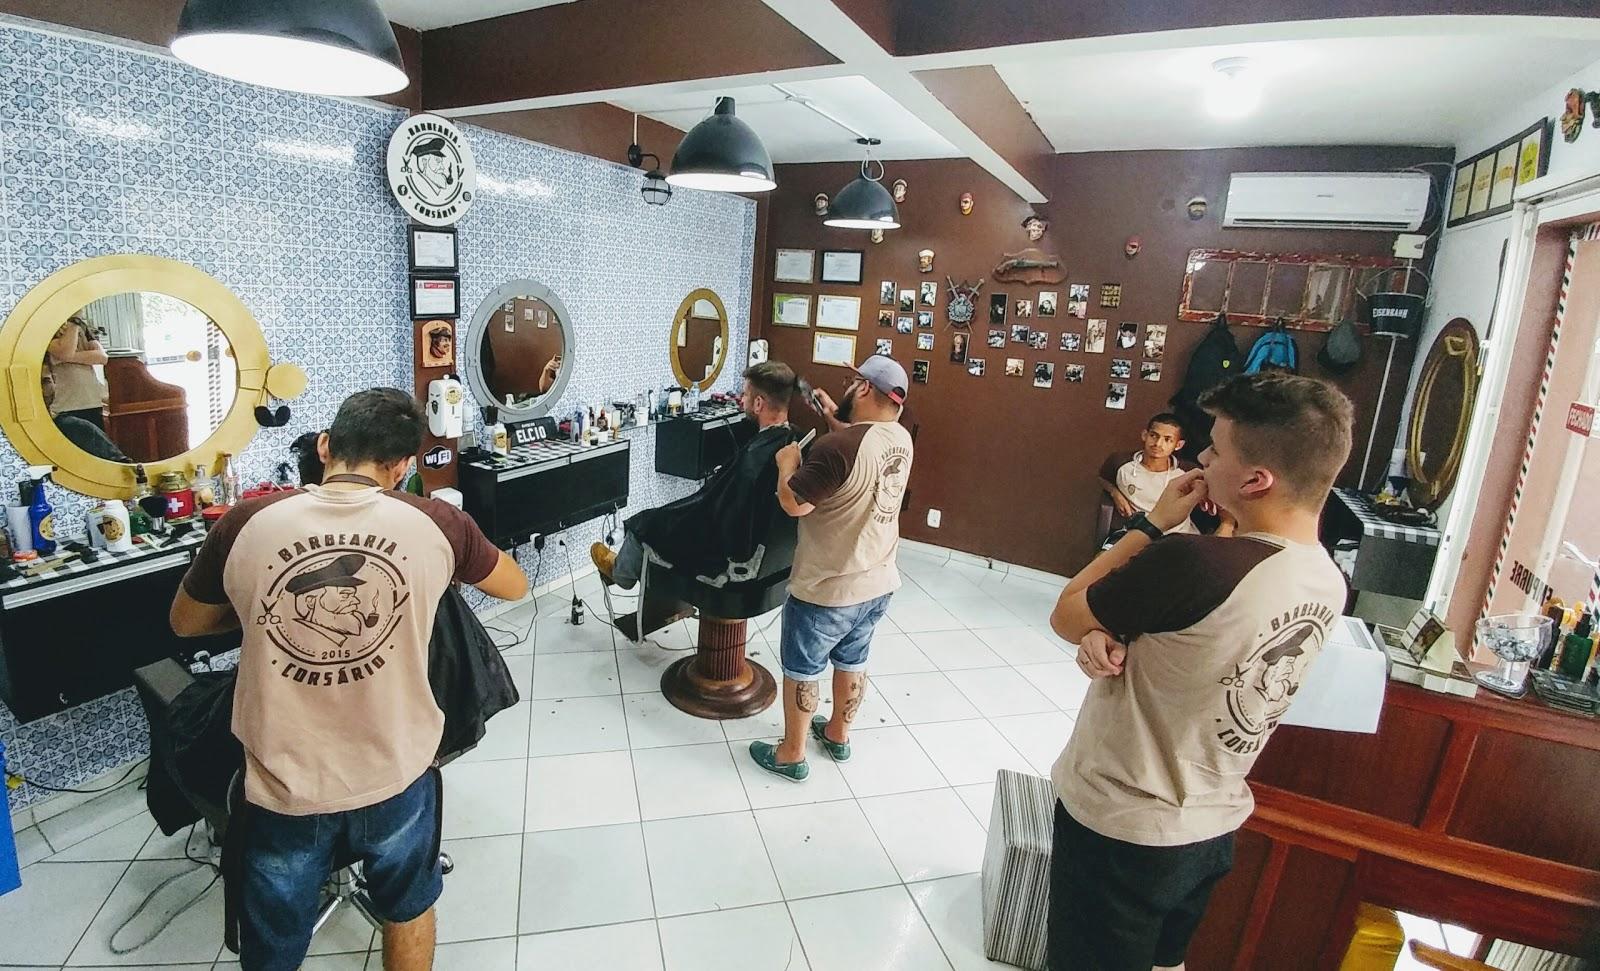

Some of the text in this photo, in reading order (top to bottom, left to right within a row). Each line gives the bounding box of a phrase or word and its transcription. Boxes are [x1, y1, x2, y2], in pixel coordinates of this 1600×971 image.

[408, 122, 458, 144] BARBEARIA
[414, 202, 457, 219] CORSÁRIO
[515, 425, 547, 443] ELCIO
[277, 533, 398, 563] BARBEARIA
[1270, 602, 1334, 632] BARBEARIA
[321, 649, 351, 660] 2015
[281, 654, 386, 686] CORSÁRIO
